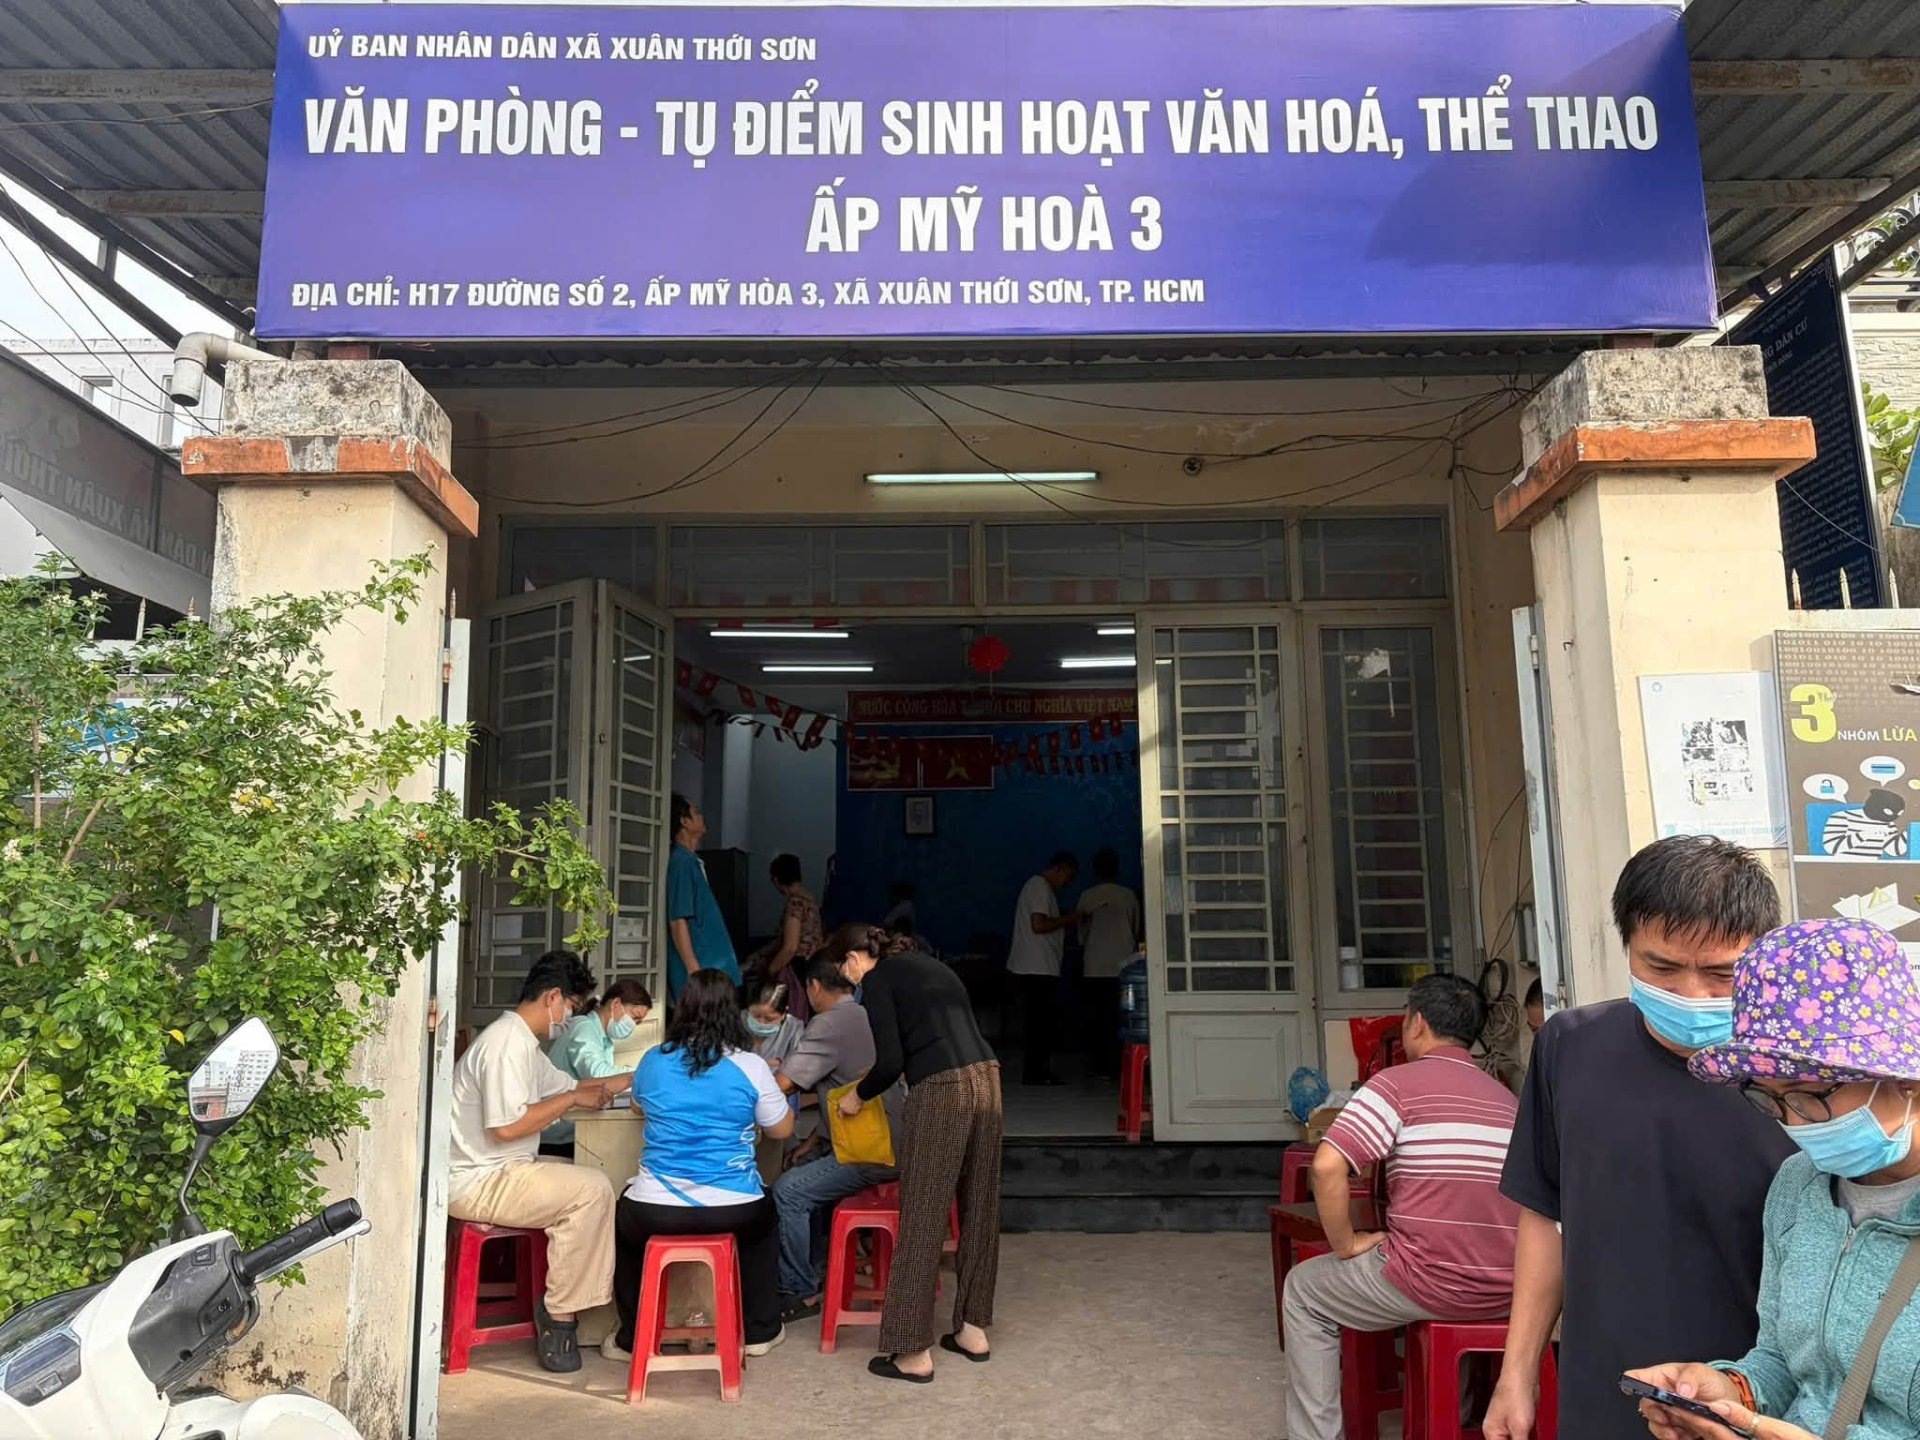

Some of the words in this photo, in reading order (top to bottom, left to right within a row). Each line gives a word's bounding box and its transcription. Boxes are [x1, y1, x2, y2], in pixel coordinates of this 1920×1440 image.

[309, 35, 343, 57] UỶ
[352, 35, 407, 57] BAN
[416, 34, 492, 58] NHÂN
[502, 34, 556, 59] DÂN
[566, 34, 601, 60] XÃ
[610, 34, 683, 60] XUÂN
[693, 34, 751, 60] THỚI
[761, 37, 815, 61] SƠN
[306, 86, 408, 155] VĂN
[426, 86, 601, 156] PHÒNG
[621, 127, 637, 137] -
[656, 102, 716, 168] TỤ
[733, 79, 862, 156] ĐIỂM
[882, 101, 1002, 156] SINH
[1022, 100, 1150, 167] HOẠT
[1166, 87, 1268, 155] VĂN
[1286, 86, 1403, 160] HOÁ,
[1419, 75, 1512, 152] THỂ
[1527, 97, 1657, 151] THAO
[806, 177, 879, 254] ẤP
[900, 186, 983, 253] MỸ
[1003, 184, 1113, 252] HOÀ
[1131, 196, 1162, 252] 3
[292, 284, 337, 311] ĐỊA
[347, 276, 399, 306] CHỈ:
[409, 284, 459, 306] H17
[468, 278, 559, 307] ĐƯỜNG
[569, 276, 605, 307] SỐ
[612, 284, 635, 309] 2,
[645, 276, 680, 306] ẤP
[690, 279, 730, 306] MỸ
[740, 278, 793, 306] HÒA
[802, 283, 825, 308] 3,
[834, 278, 870, 305] XÃ
[879, 277, 951, 305] XUÂN
[960, 276, 1018, 305] THỚI
[1028, 278, 1091, 306] SƠN,
[1099, 280, 1134, 303] TP.
[1144, 280, 1204, 303] HCM
[1790, 683, 1838, 743] 3
[1837, 728, 1880, 741] NHÓM
[1882, 725, 1918, 742] LỪA
